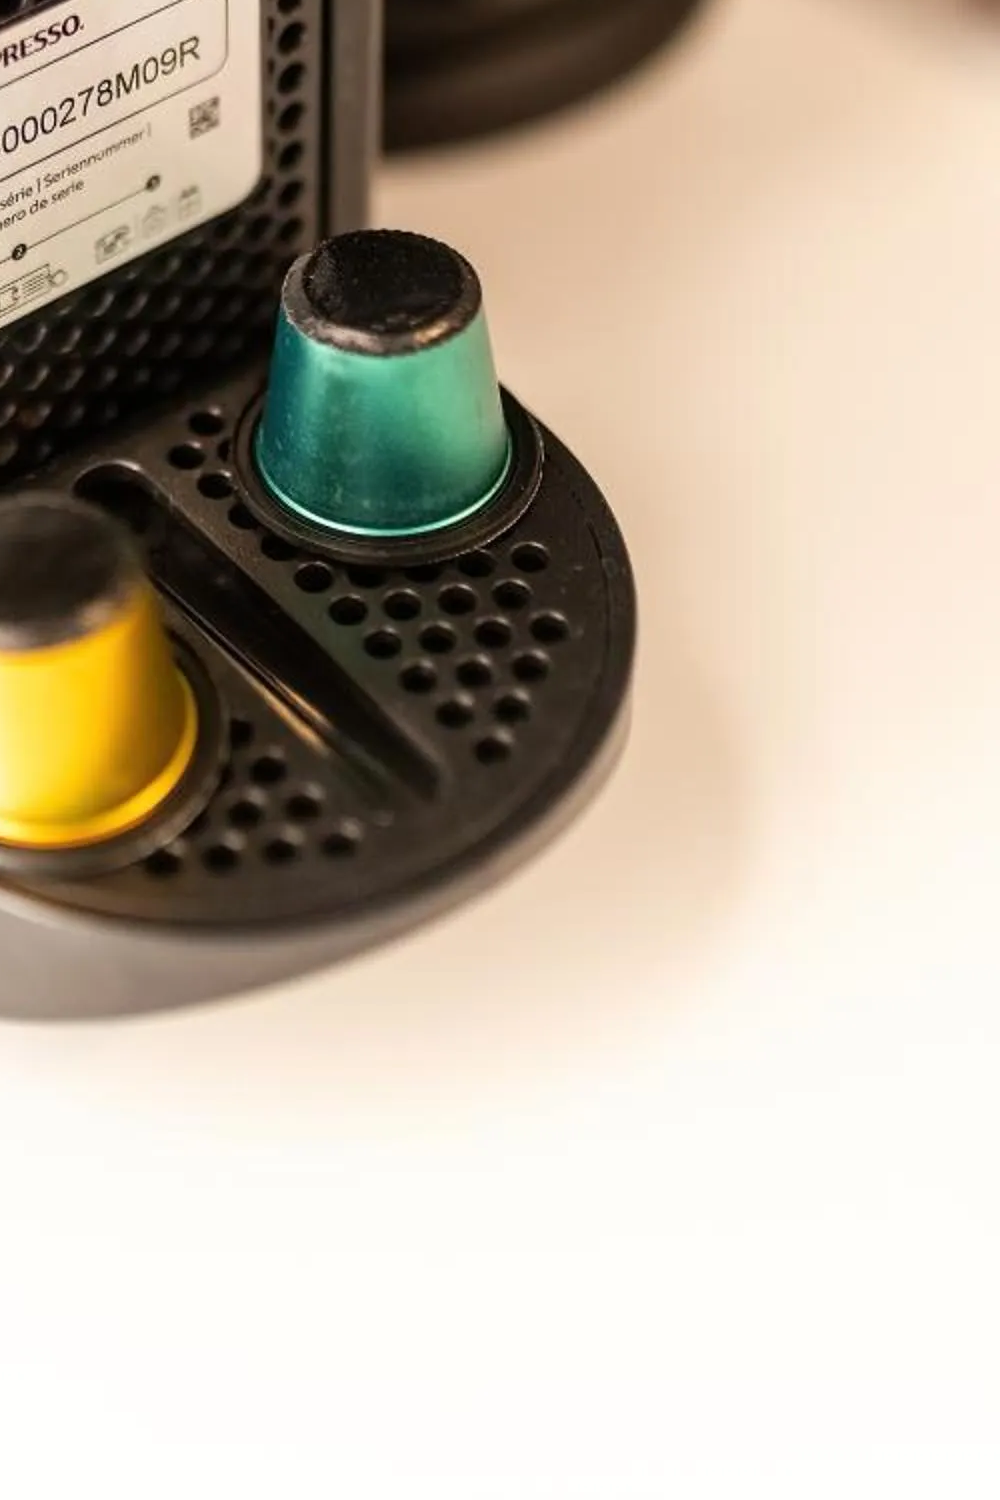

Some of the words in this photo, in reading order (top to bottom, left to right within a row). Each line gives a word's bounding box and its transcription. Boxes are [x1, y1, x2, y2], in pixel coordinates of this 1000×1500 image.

[0, 184, 34, 210] série
[44, 128, 144, 189] Seriennummer
[29, 196, 49, 215] de
[51, 178, 85, 205] serie
